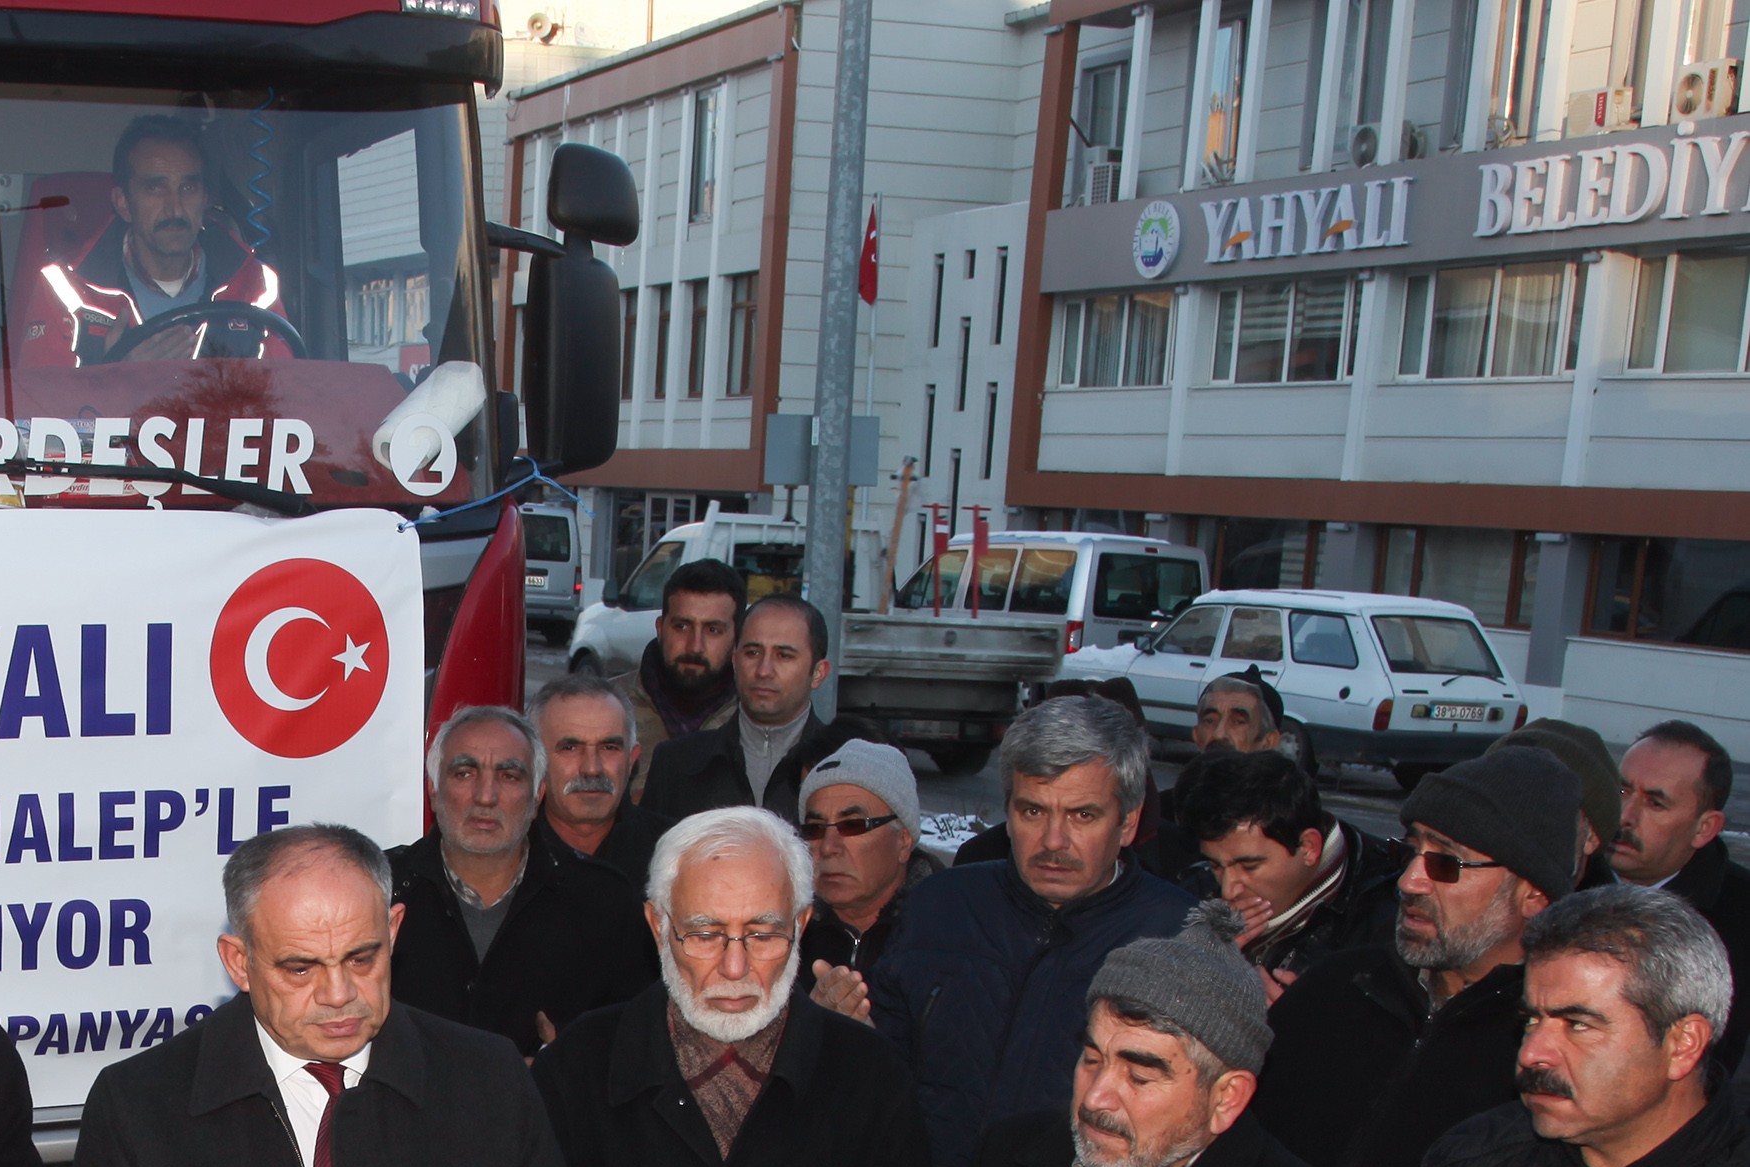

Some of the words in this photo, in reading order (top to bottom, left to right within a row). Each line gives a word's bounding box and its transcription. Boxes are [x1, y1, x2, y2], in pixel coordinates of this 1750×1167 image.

[1200, 179, 1410, 264] YAHYALI
[1472, 120, 1750, 238] BELEDİY
[1434, 705, 1447, 718] 38
